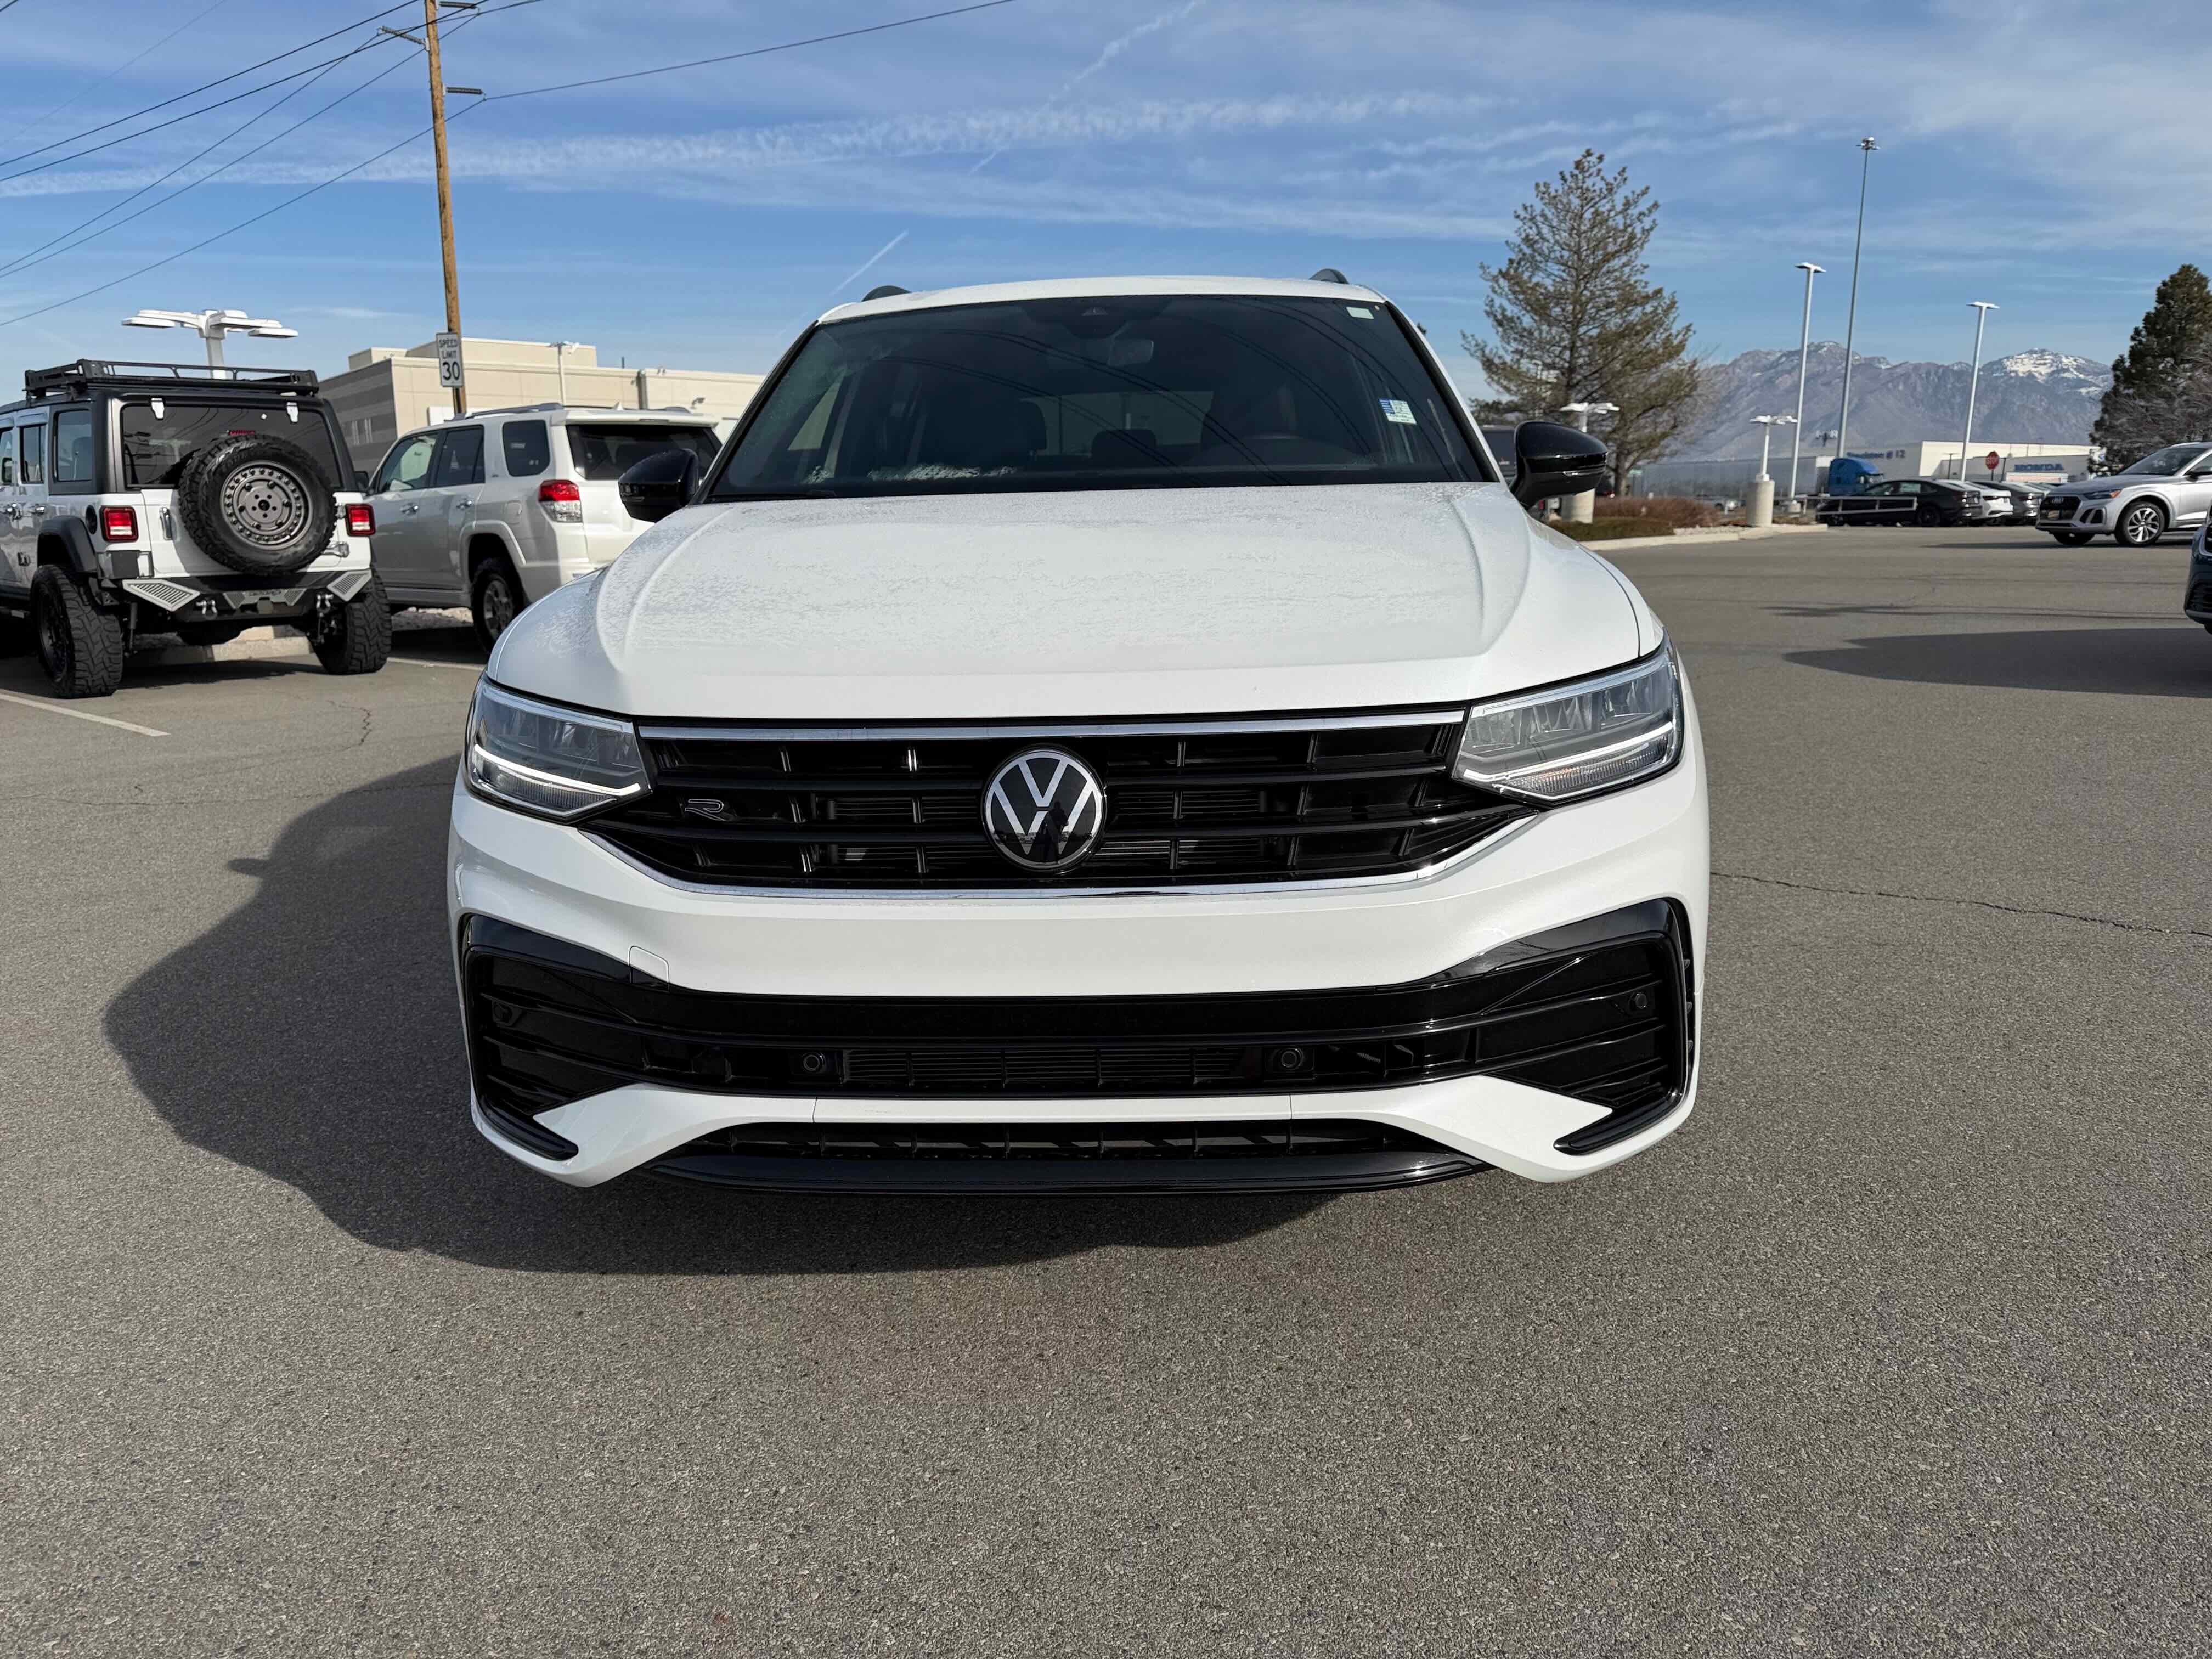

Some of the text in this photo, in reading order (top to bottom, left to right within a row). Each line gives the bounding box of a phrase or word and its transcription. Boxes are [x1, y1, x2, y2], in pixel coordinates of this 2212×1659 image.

[439, 339, 458, 348] SPEED
[442, 351, 457, 359] LIMIT
[443, 361, 460, 380] 30
[1987, 456, 1998, 465] STOP
[685, 799, 725, 821] R
[989, 754, 1097, 855] VW
